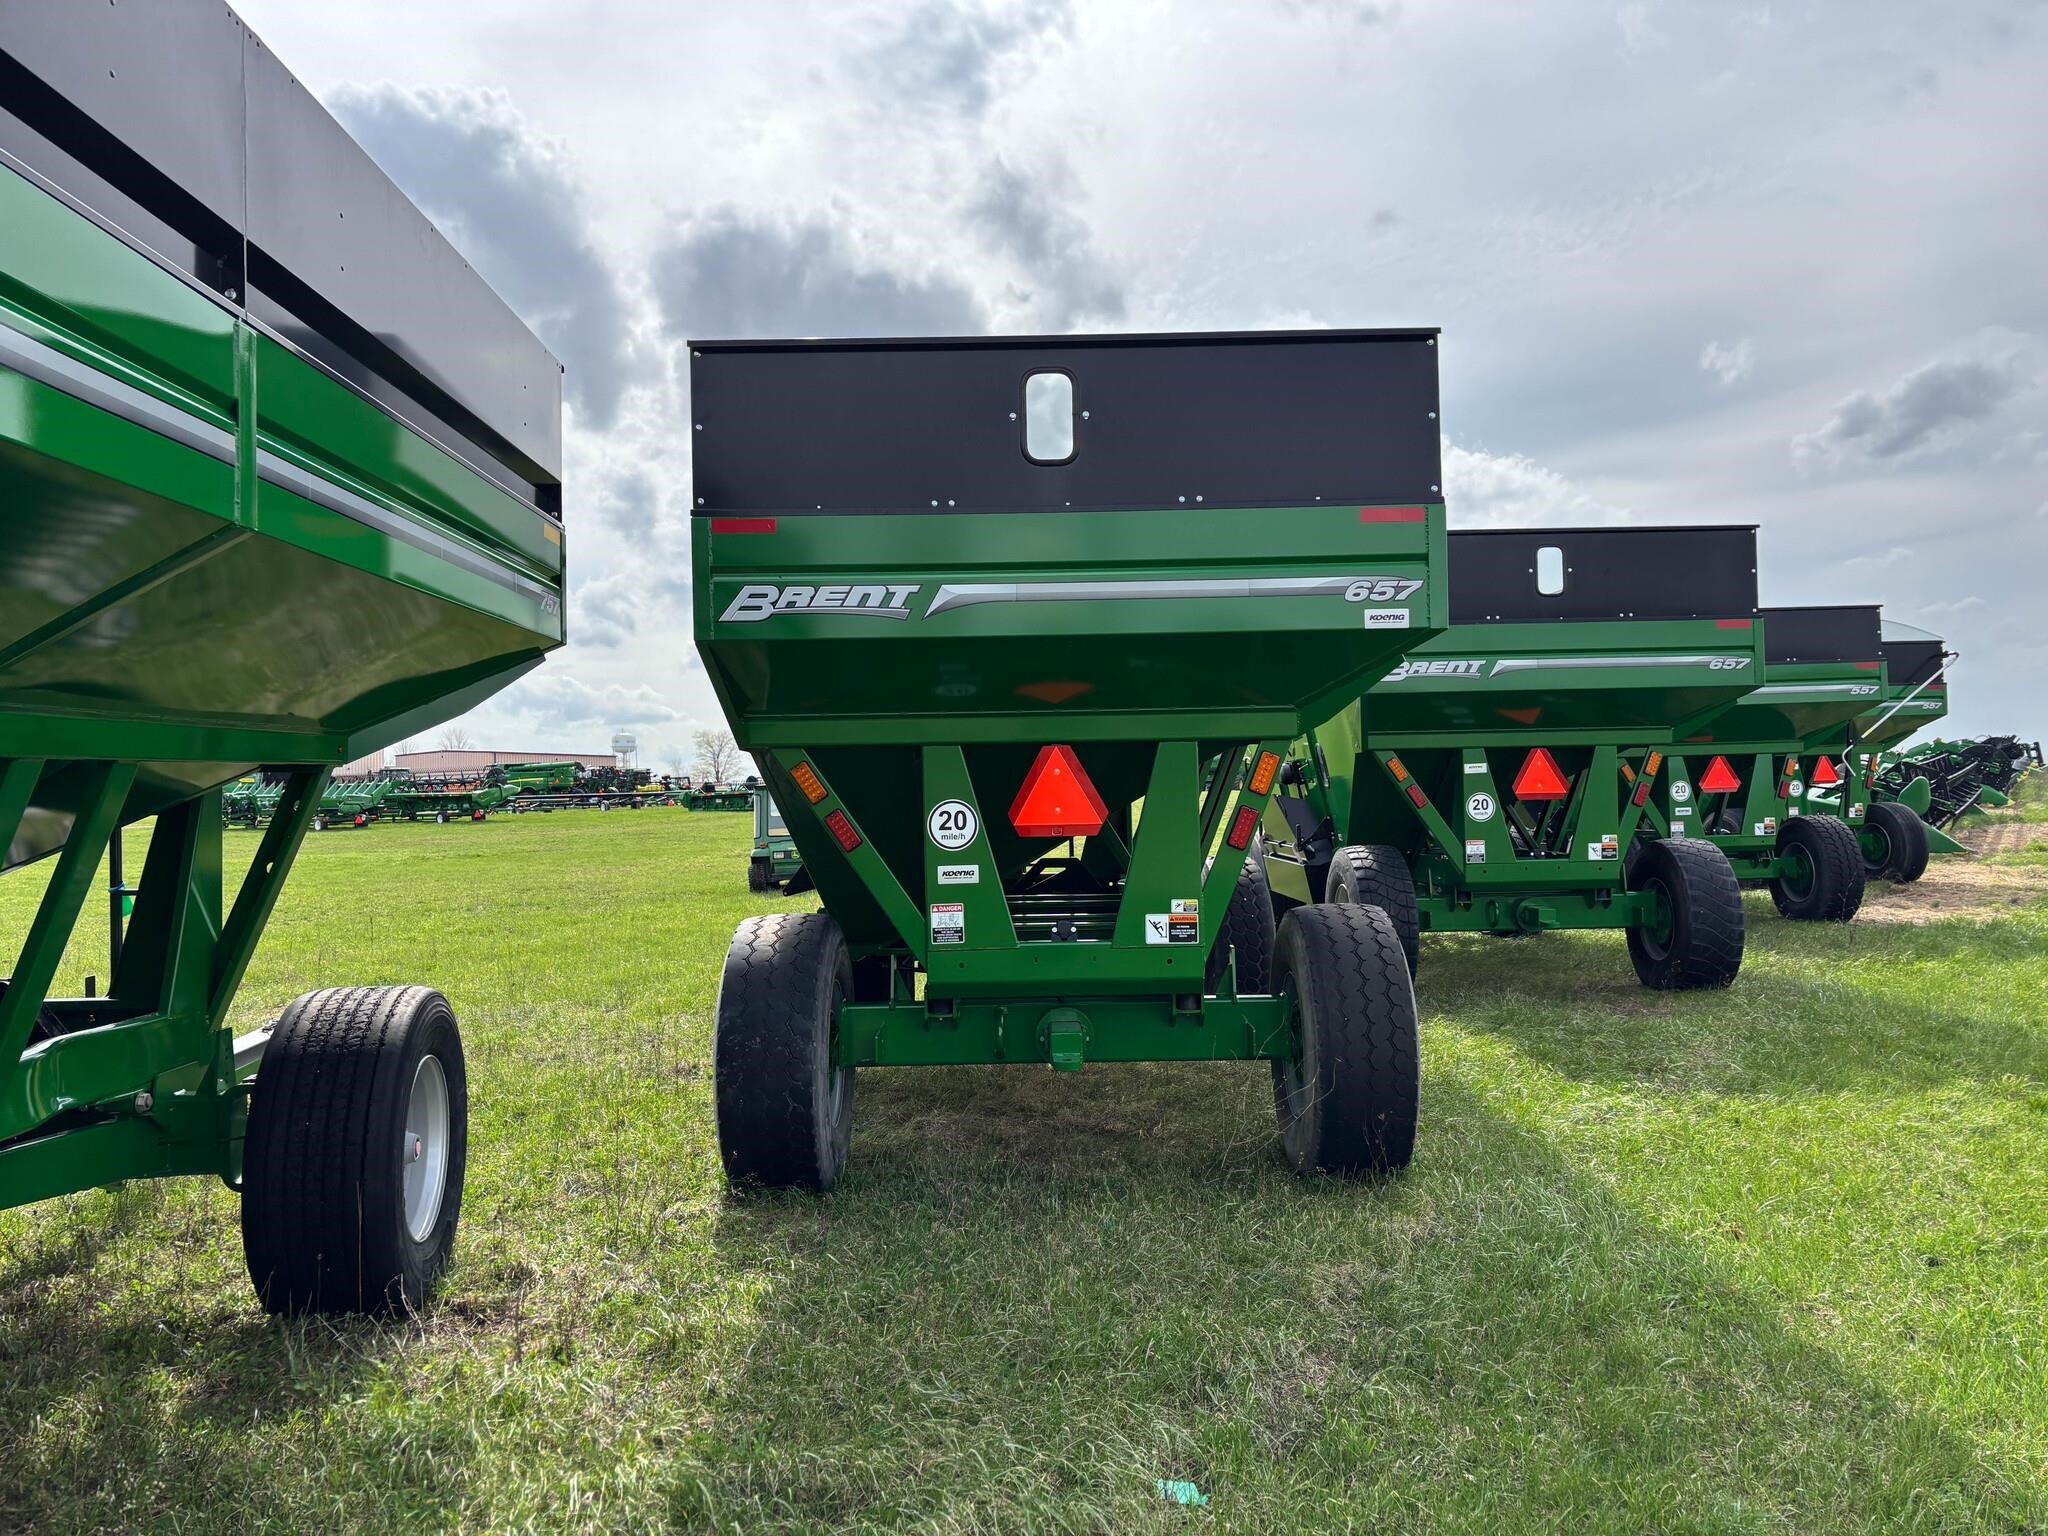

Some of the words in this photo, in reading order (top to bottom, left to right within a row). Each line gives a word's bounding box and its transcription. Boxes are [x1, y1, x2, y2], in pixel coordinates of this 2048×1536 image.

[1344, 579, 1424, 602] 657
[718, 584, 921, 621] BRENT
[1709, 657, 1752, 670] 657
[1850, 686, 1880, 695] 557
[1675, 785, 1687, 794] 20
[1473, 799, 1489, 810] 20
[938, 810, 967, 831] 20
